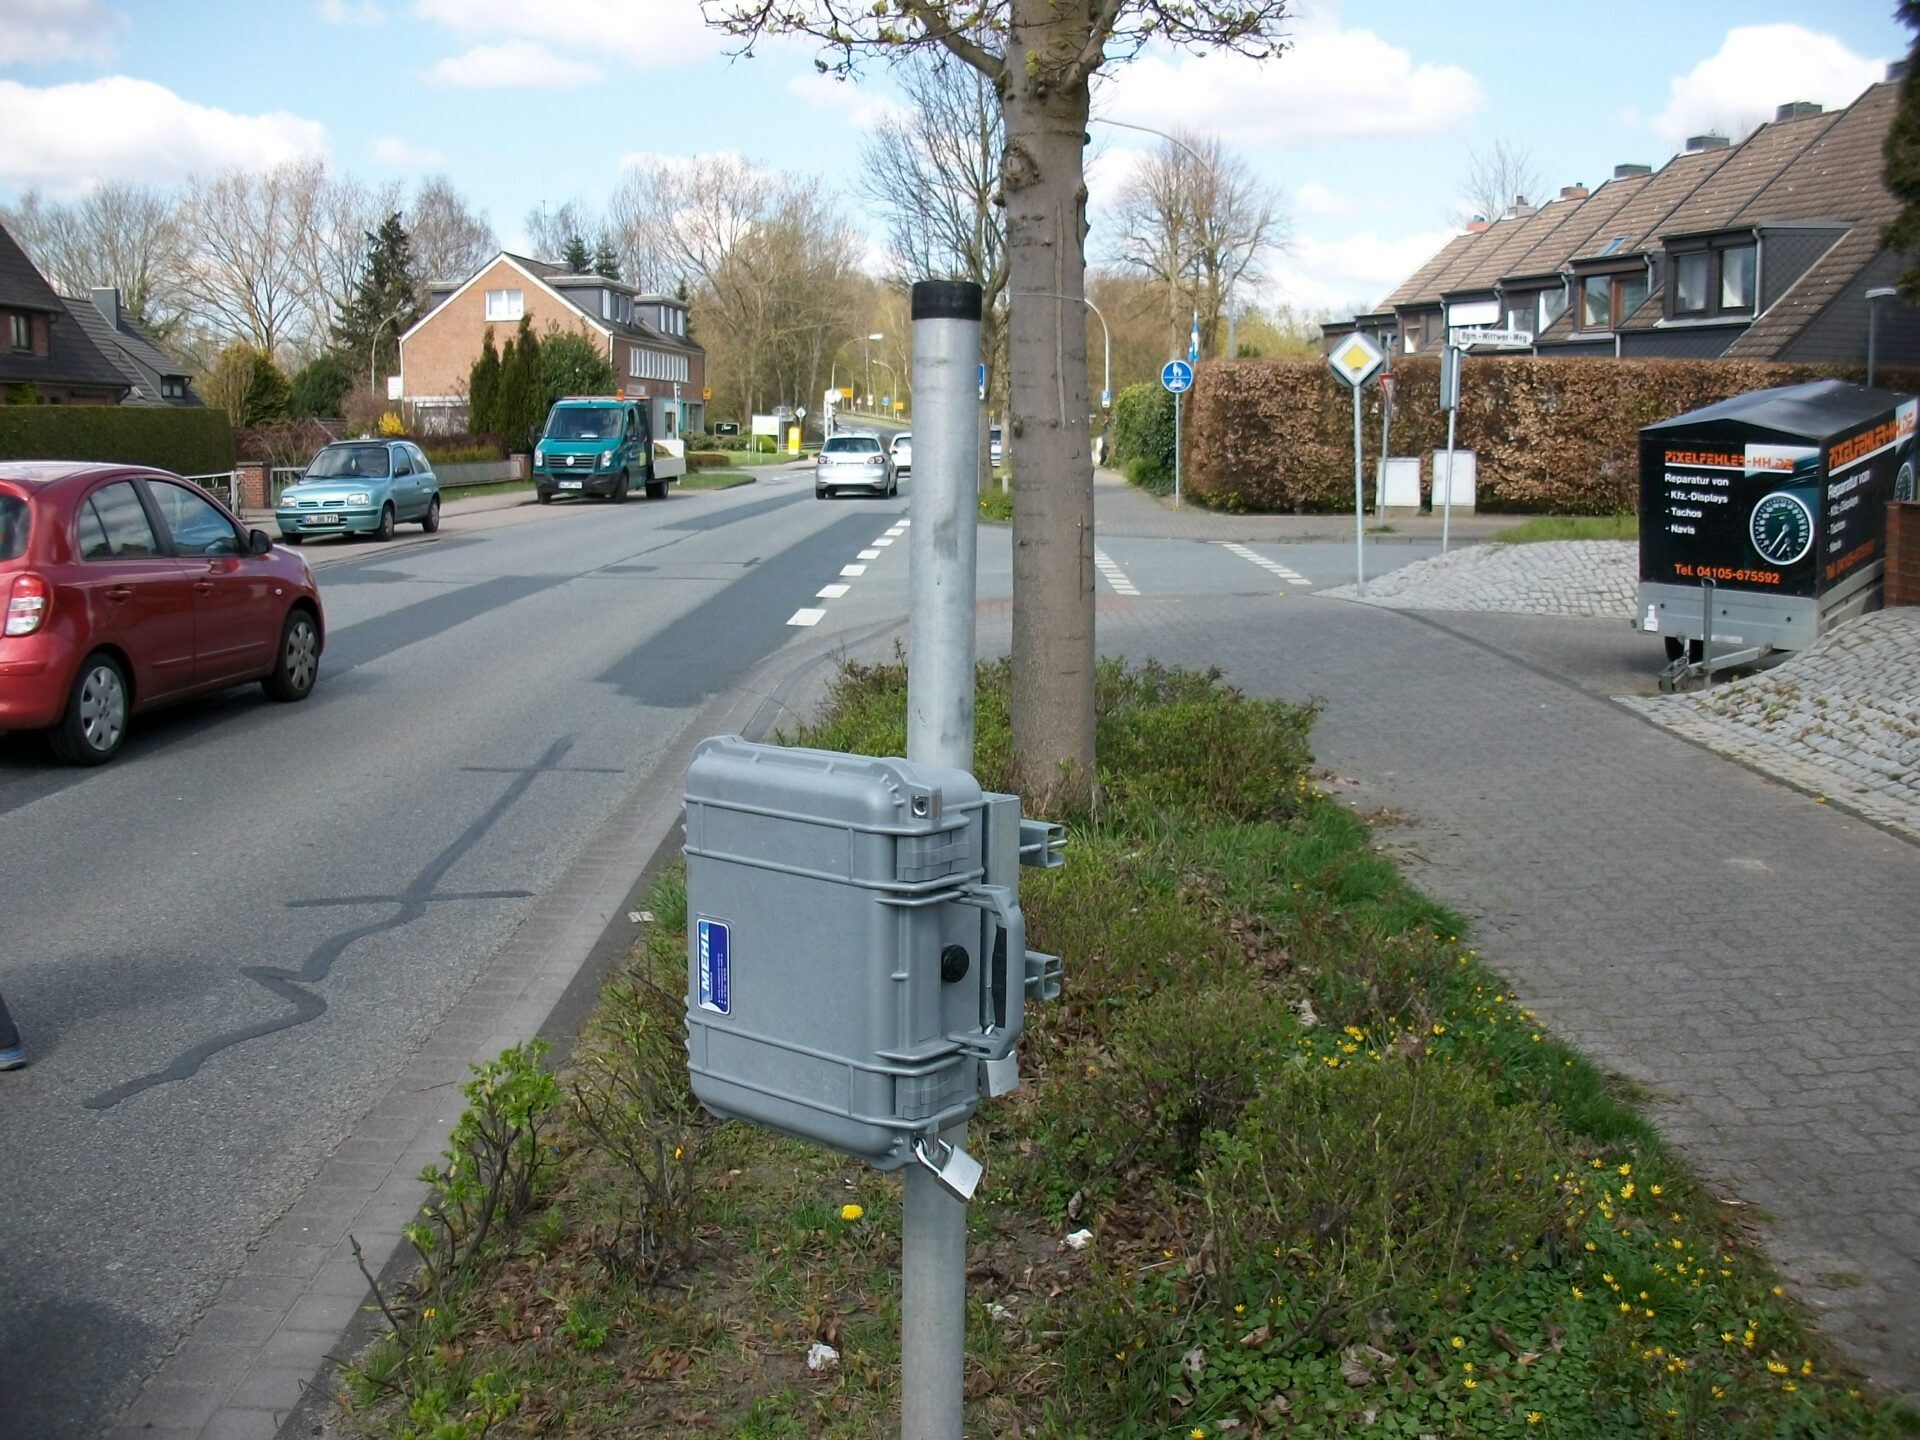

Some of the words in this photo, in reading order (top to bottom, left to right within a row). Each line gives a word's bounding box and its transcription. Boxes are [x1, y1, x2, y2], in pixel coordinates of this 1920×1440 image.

[1664, 473, 1709, 485] Reparatur
[1711, 478, 1729, 487] von
[1670, 506, 1703, 519] Tachos
[1670, 524, 1696, 535] Navis
[1674, 563, 1694, 576] Tel.
[1697, 566, 1780, 585] 04105-675592
[701, 929, 710, 992] MEHL
